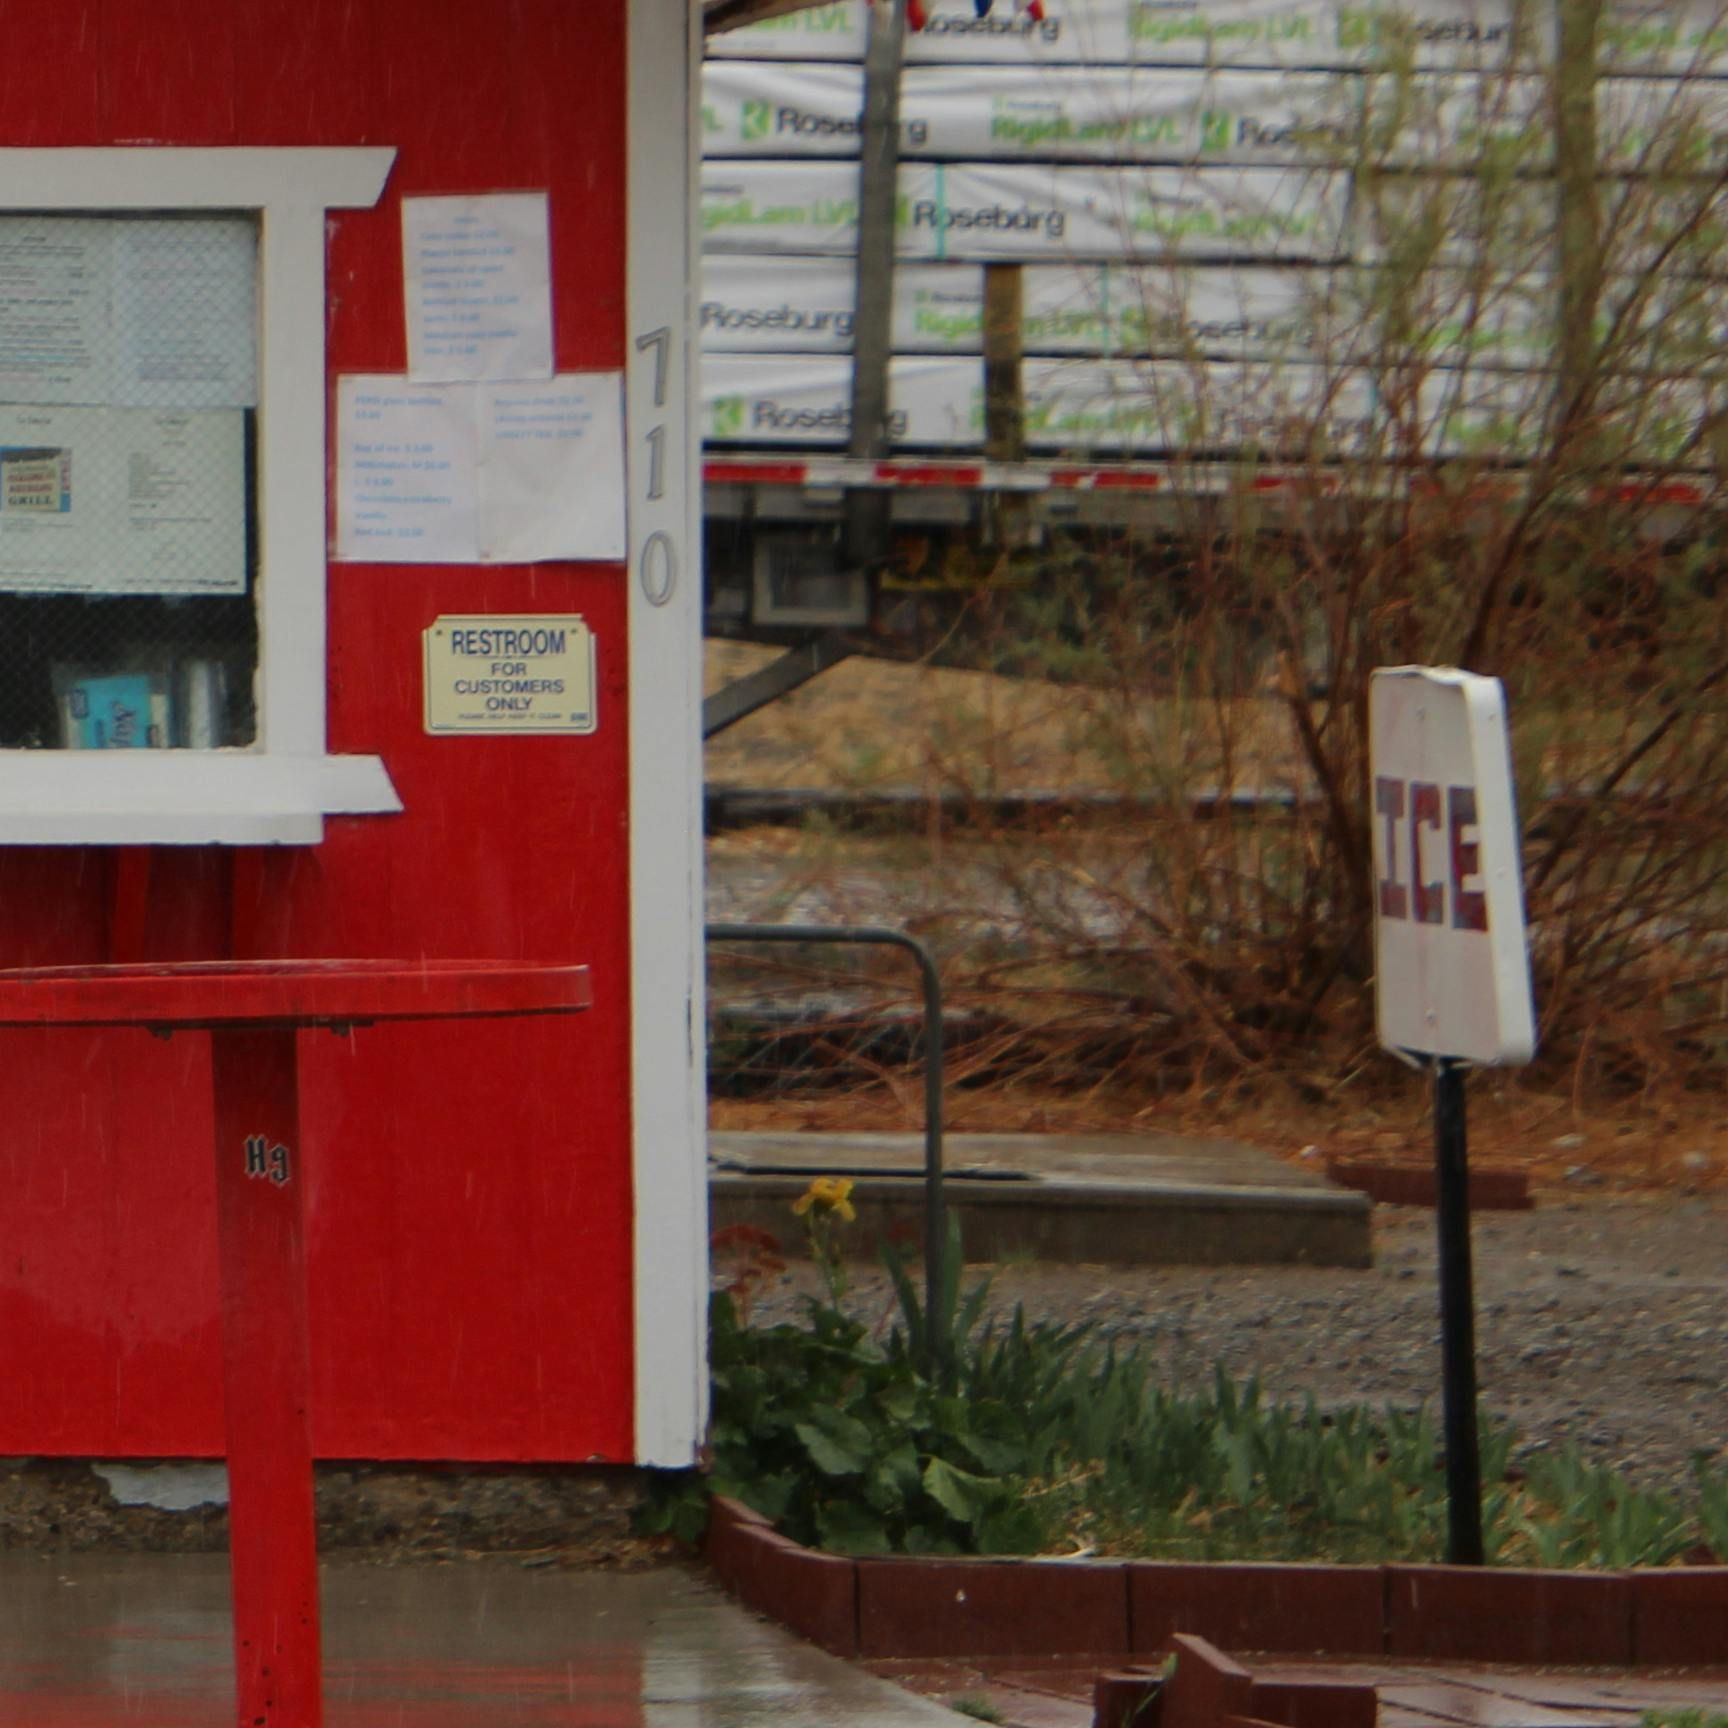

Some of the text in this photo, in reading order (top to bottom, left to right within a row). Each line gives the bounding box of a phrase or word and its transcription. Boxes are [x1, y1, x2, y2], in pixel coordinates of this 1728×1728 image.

[913, 201, 1064, 237] Roseburg
[699, 300, 854, 335] Roseburg
[752, 400, 908, 437] Rosebg
[452, 630, 565, 654] RESTROOM
[491, 662, 527, 676] FOR
[454, 680, 564, 694] CUSTOMERS
[486, 697, 532, 711] ONLY
[1376, 775, 1489, 931] ICE
[243, 1134, 291, 1187] Hg
